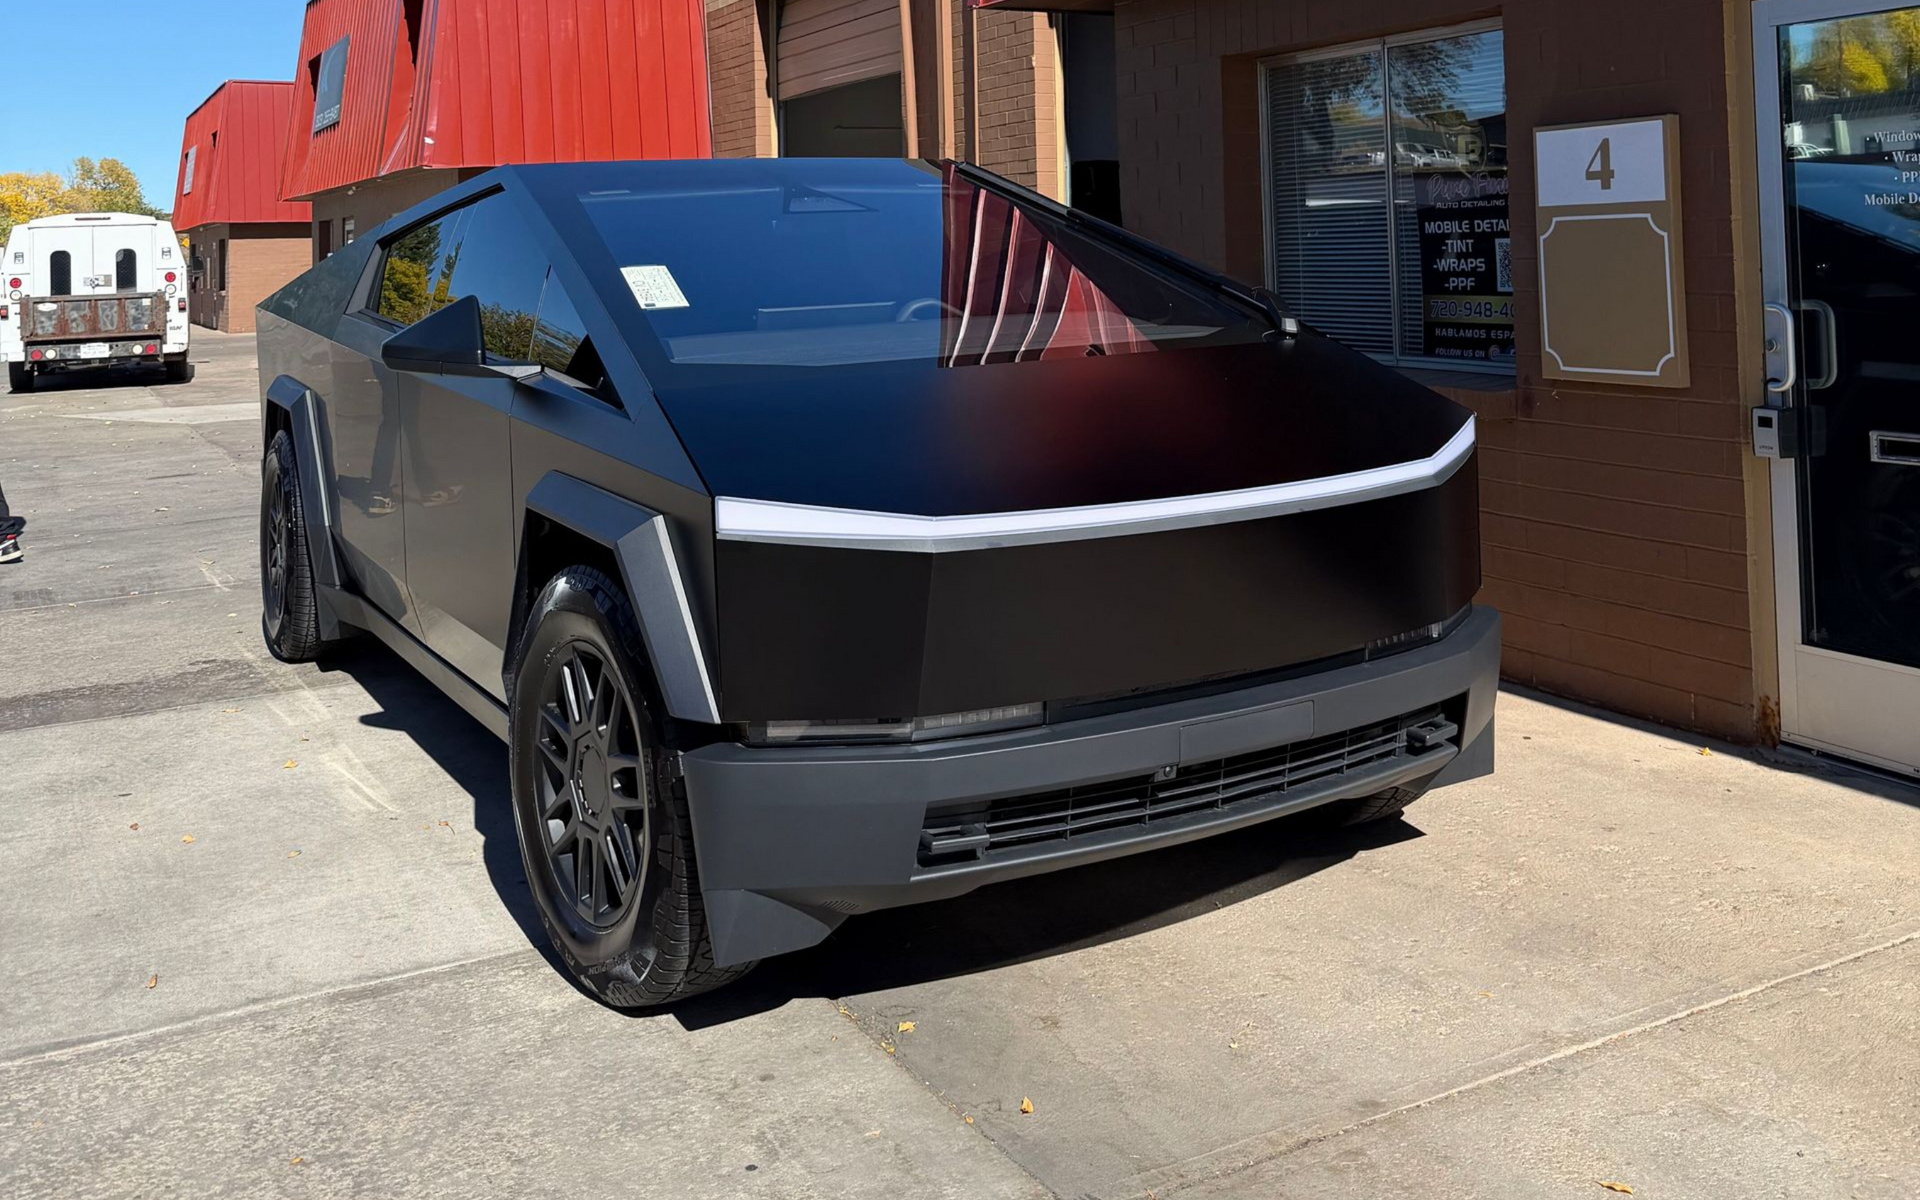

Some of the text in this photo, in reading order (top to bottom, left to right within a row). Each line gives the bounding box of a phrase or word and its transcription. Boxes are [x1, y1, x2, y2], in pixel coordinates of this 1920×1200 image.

[1585, 137, 1615, 190] 4
[1902, 171, 1920, 183] PP
[1435, 199, 1505, 209] AUTO DETAILING
[1864, 192, 1920, 206] Mobile D
[1425, 220, 1470, 234] MOBILE
[1442, 239, 1474, 253] -TINT
[1433, 258, 1486, 272] -WRAPS
[1444, 277, 1475, 291] -PPF
[1435, 327, 1487, 338] HABLAMOS
[1435, 347, 1485, 358] FOLLOW US ON
